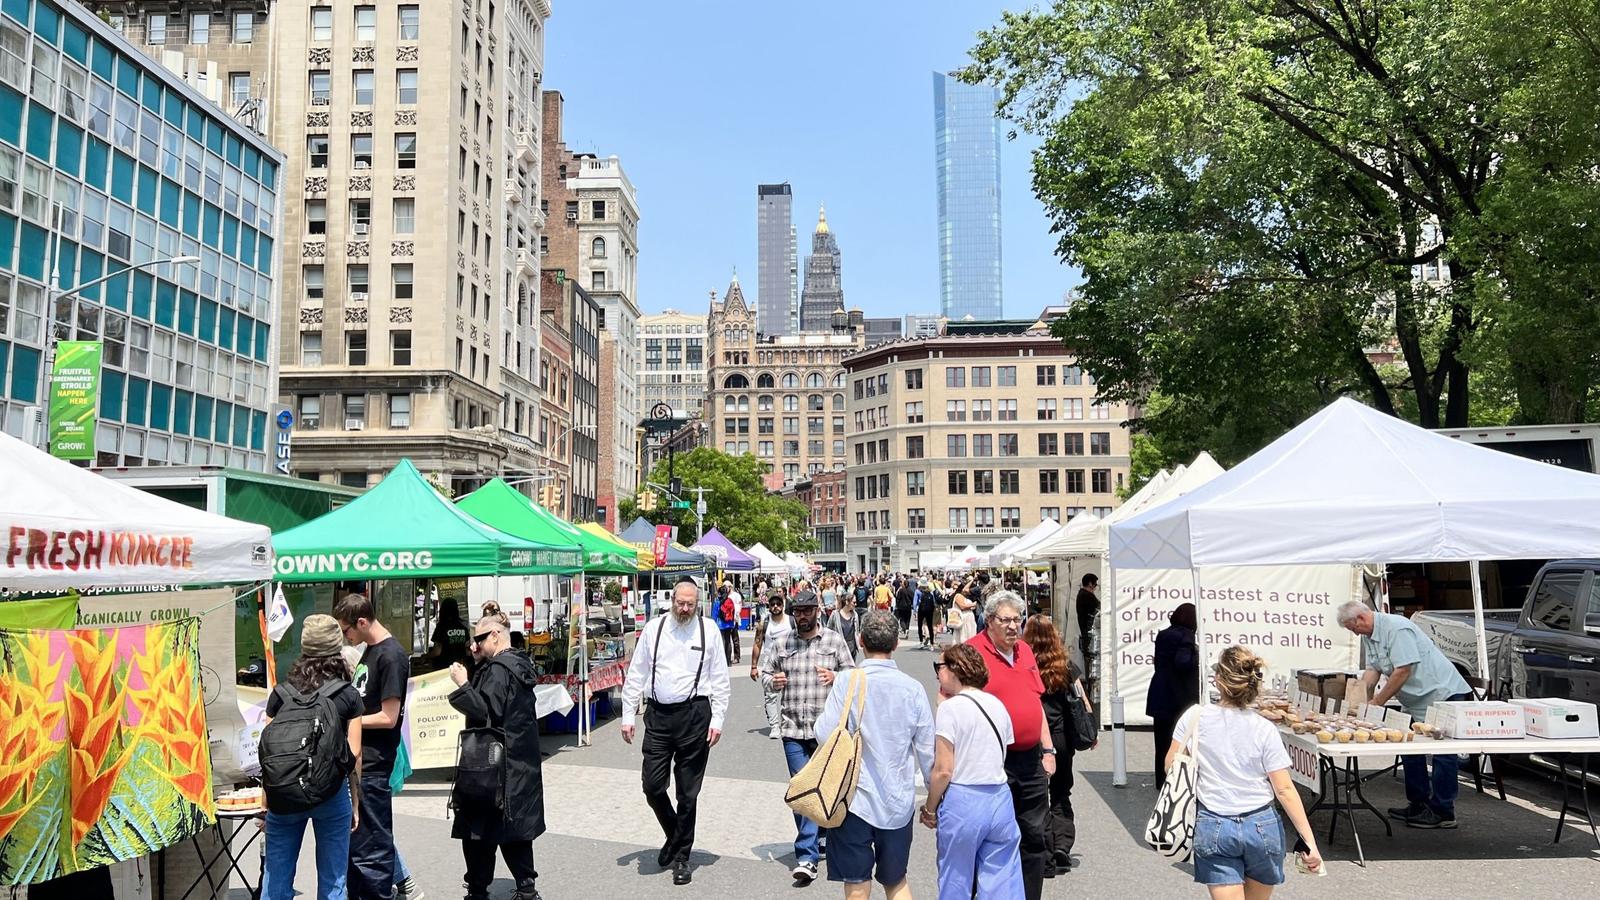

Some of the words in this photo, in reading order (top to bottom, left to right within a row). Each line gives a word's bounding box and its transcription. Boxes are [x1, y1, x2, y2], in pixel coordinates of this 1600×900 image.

[6, 525, 105, 571] FRESH
[108, 530, 194, 570] KIMCEE
[1150, 586, 1192, 599] thou
[1200, 587, 1262, 601] tastest
[1269, 591, 1279, 602] a
[1286, 592, 1331, 605] crust
[77, 610, 142, 626] RGANICALLY
[150, 608, 190, 621] GROWN
[1122, 607, 1141, 621] of
[1213, 608, 1256, 623] thou
[1264, 610, 1324, 627] tastest
[1122, 629, 1142, 643] all
[1203, 632, 1232, 644] ars
[1239, 632, 1273, 646] and
[1280, 633, 1300, 647] all
[1306, 634, 1332, 649] the
[417, 715, 448, 723] FOLLOW
